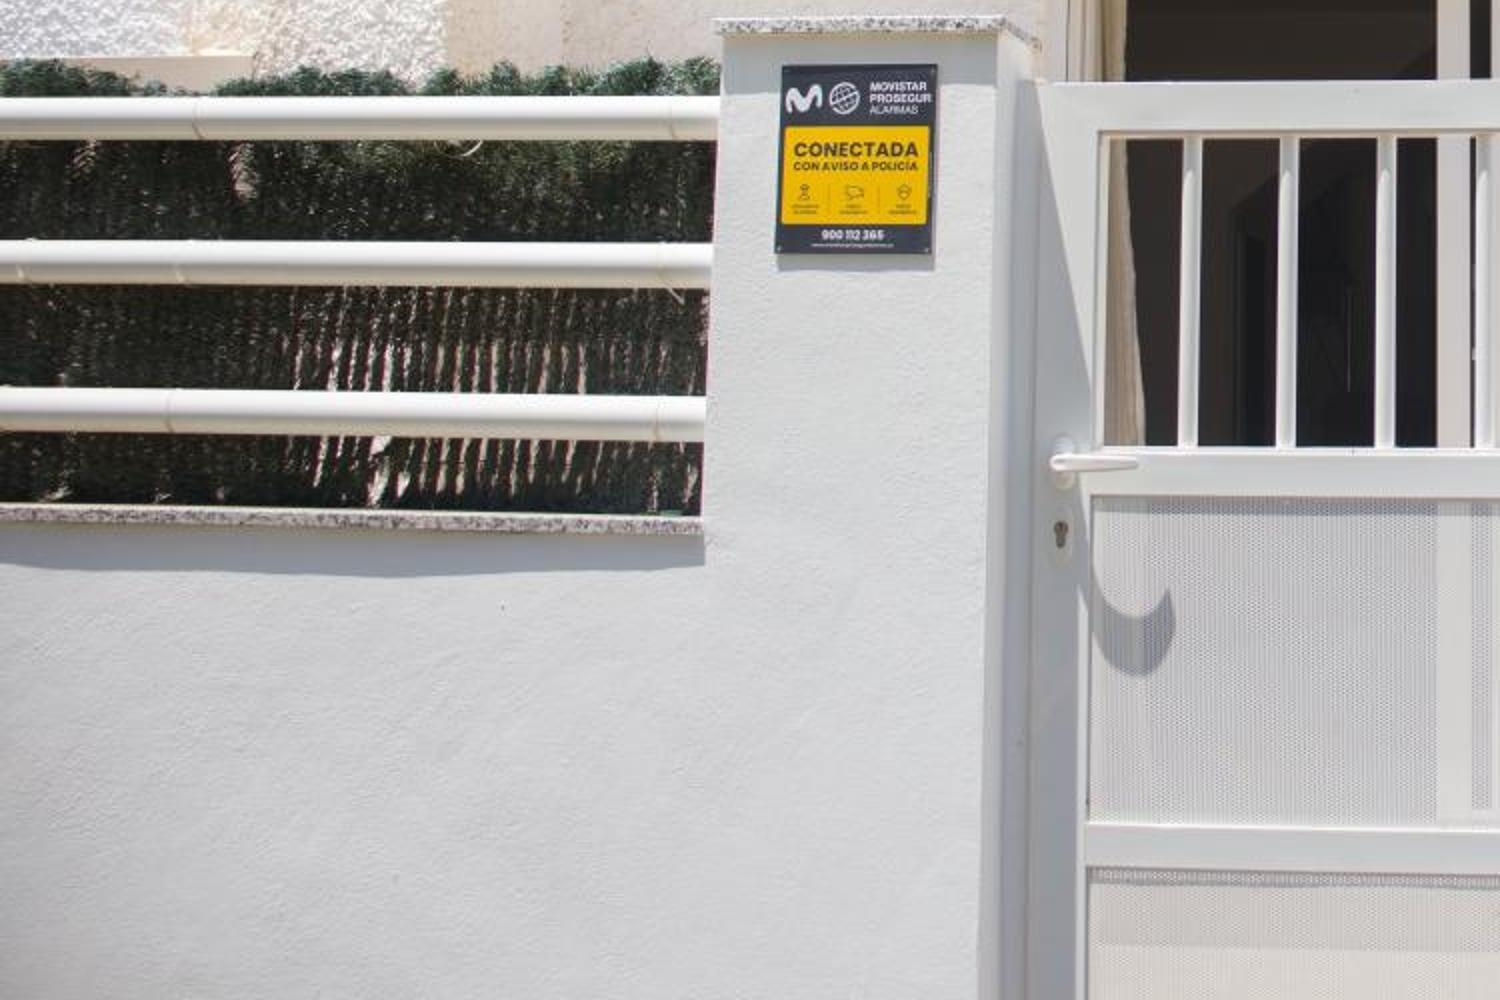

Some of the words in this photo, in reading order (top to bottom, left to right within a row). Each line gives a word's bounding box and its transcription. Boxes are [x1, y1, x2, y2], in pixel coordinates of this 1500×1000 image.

[869, 82, 927, 92] MOVISTAR
[869, 93, 932, 103] PROSEGUR
[869, 105, 919, 114] ALARMAS
[794, 142, 919, 157] CONECTADA
[794, 161, 819, 171] CON
[822, 161, 858, 171] AVISO
[862, 161, 870, 171] A
[822, 229, 844, 240] 900
[846, 229, 860, 240] 112
